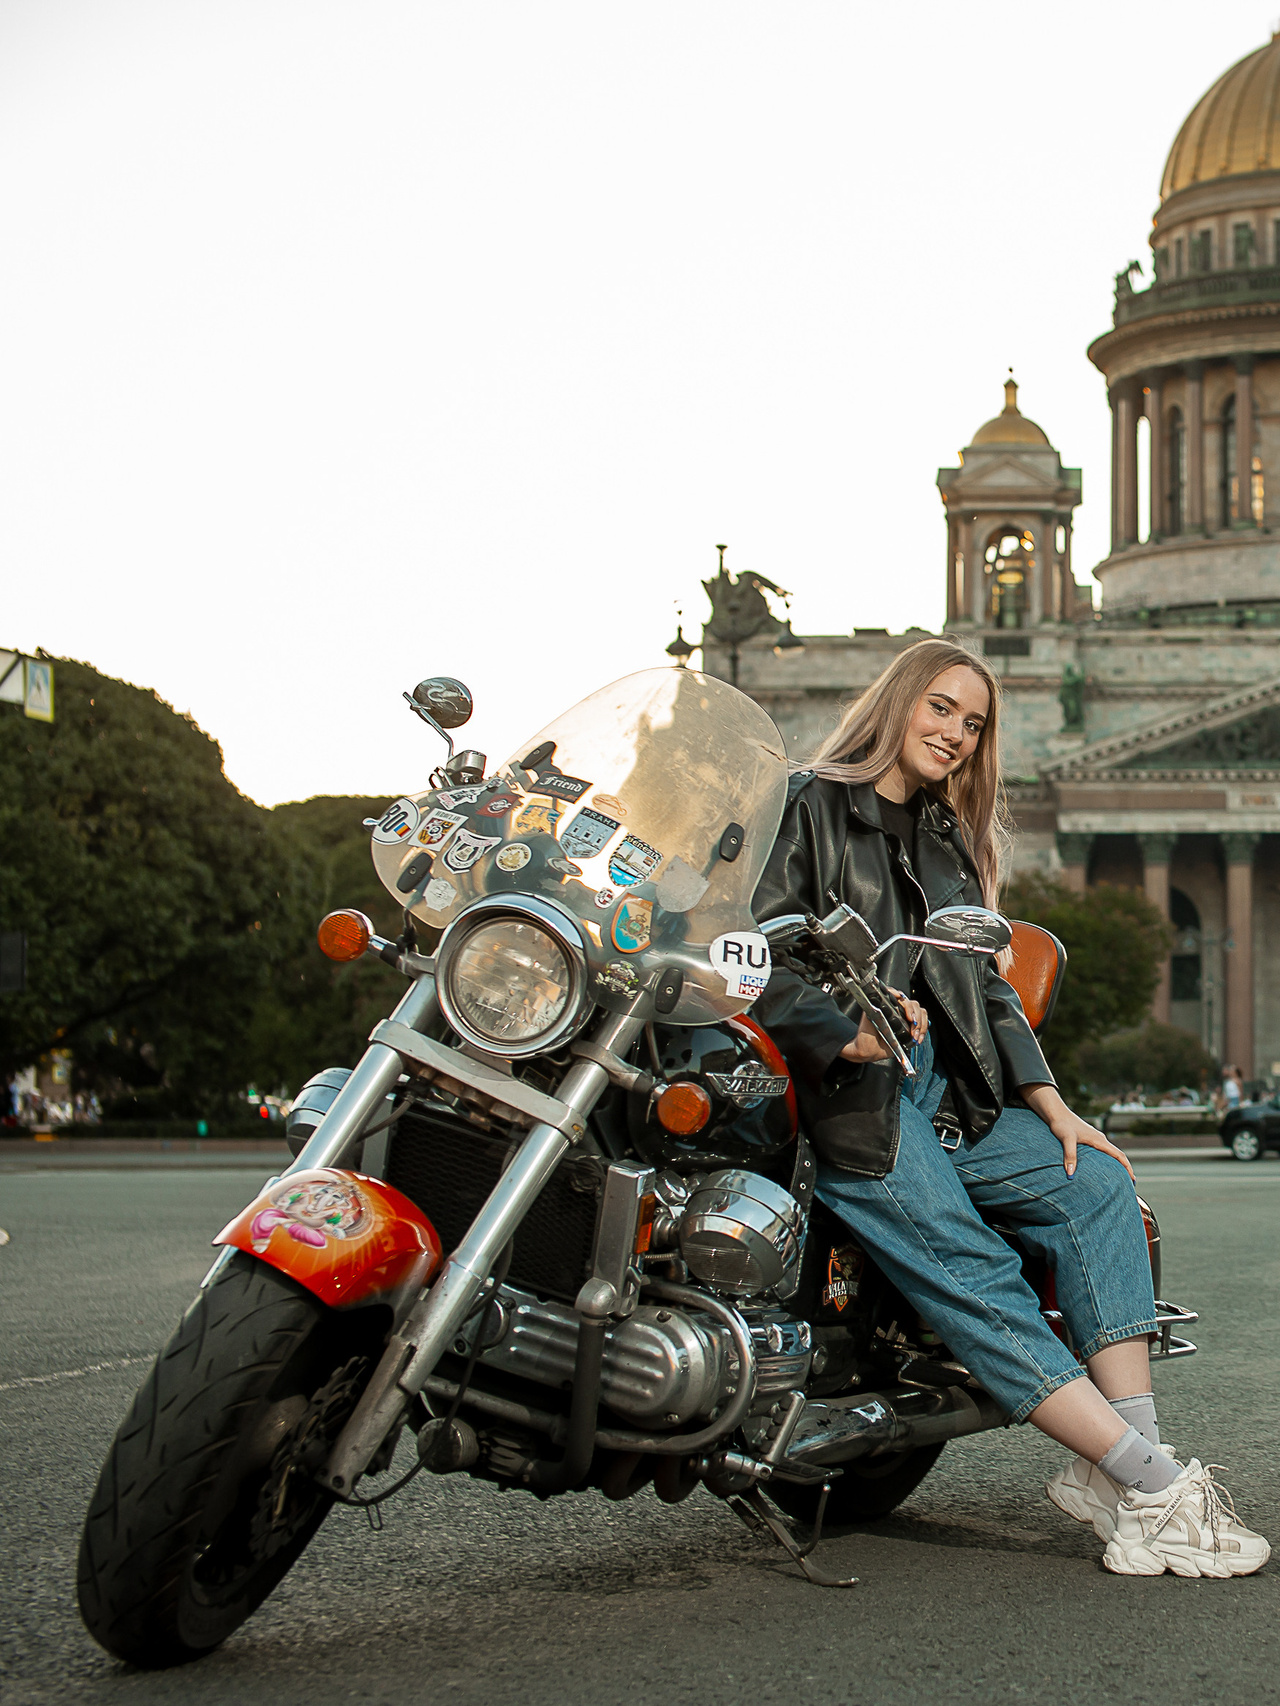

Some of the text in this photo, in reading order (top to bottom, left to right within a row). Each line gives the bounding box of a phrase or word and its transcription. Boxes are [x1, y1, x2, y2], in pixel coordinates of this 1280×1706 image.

[583, 809, 617, 829] PRAHA
[723, 940, 767, 969] RU
[740, 985, 764, 997] MOL
